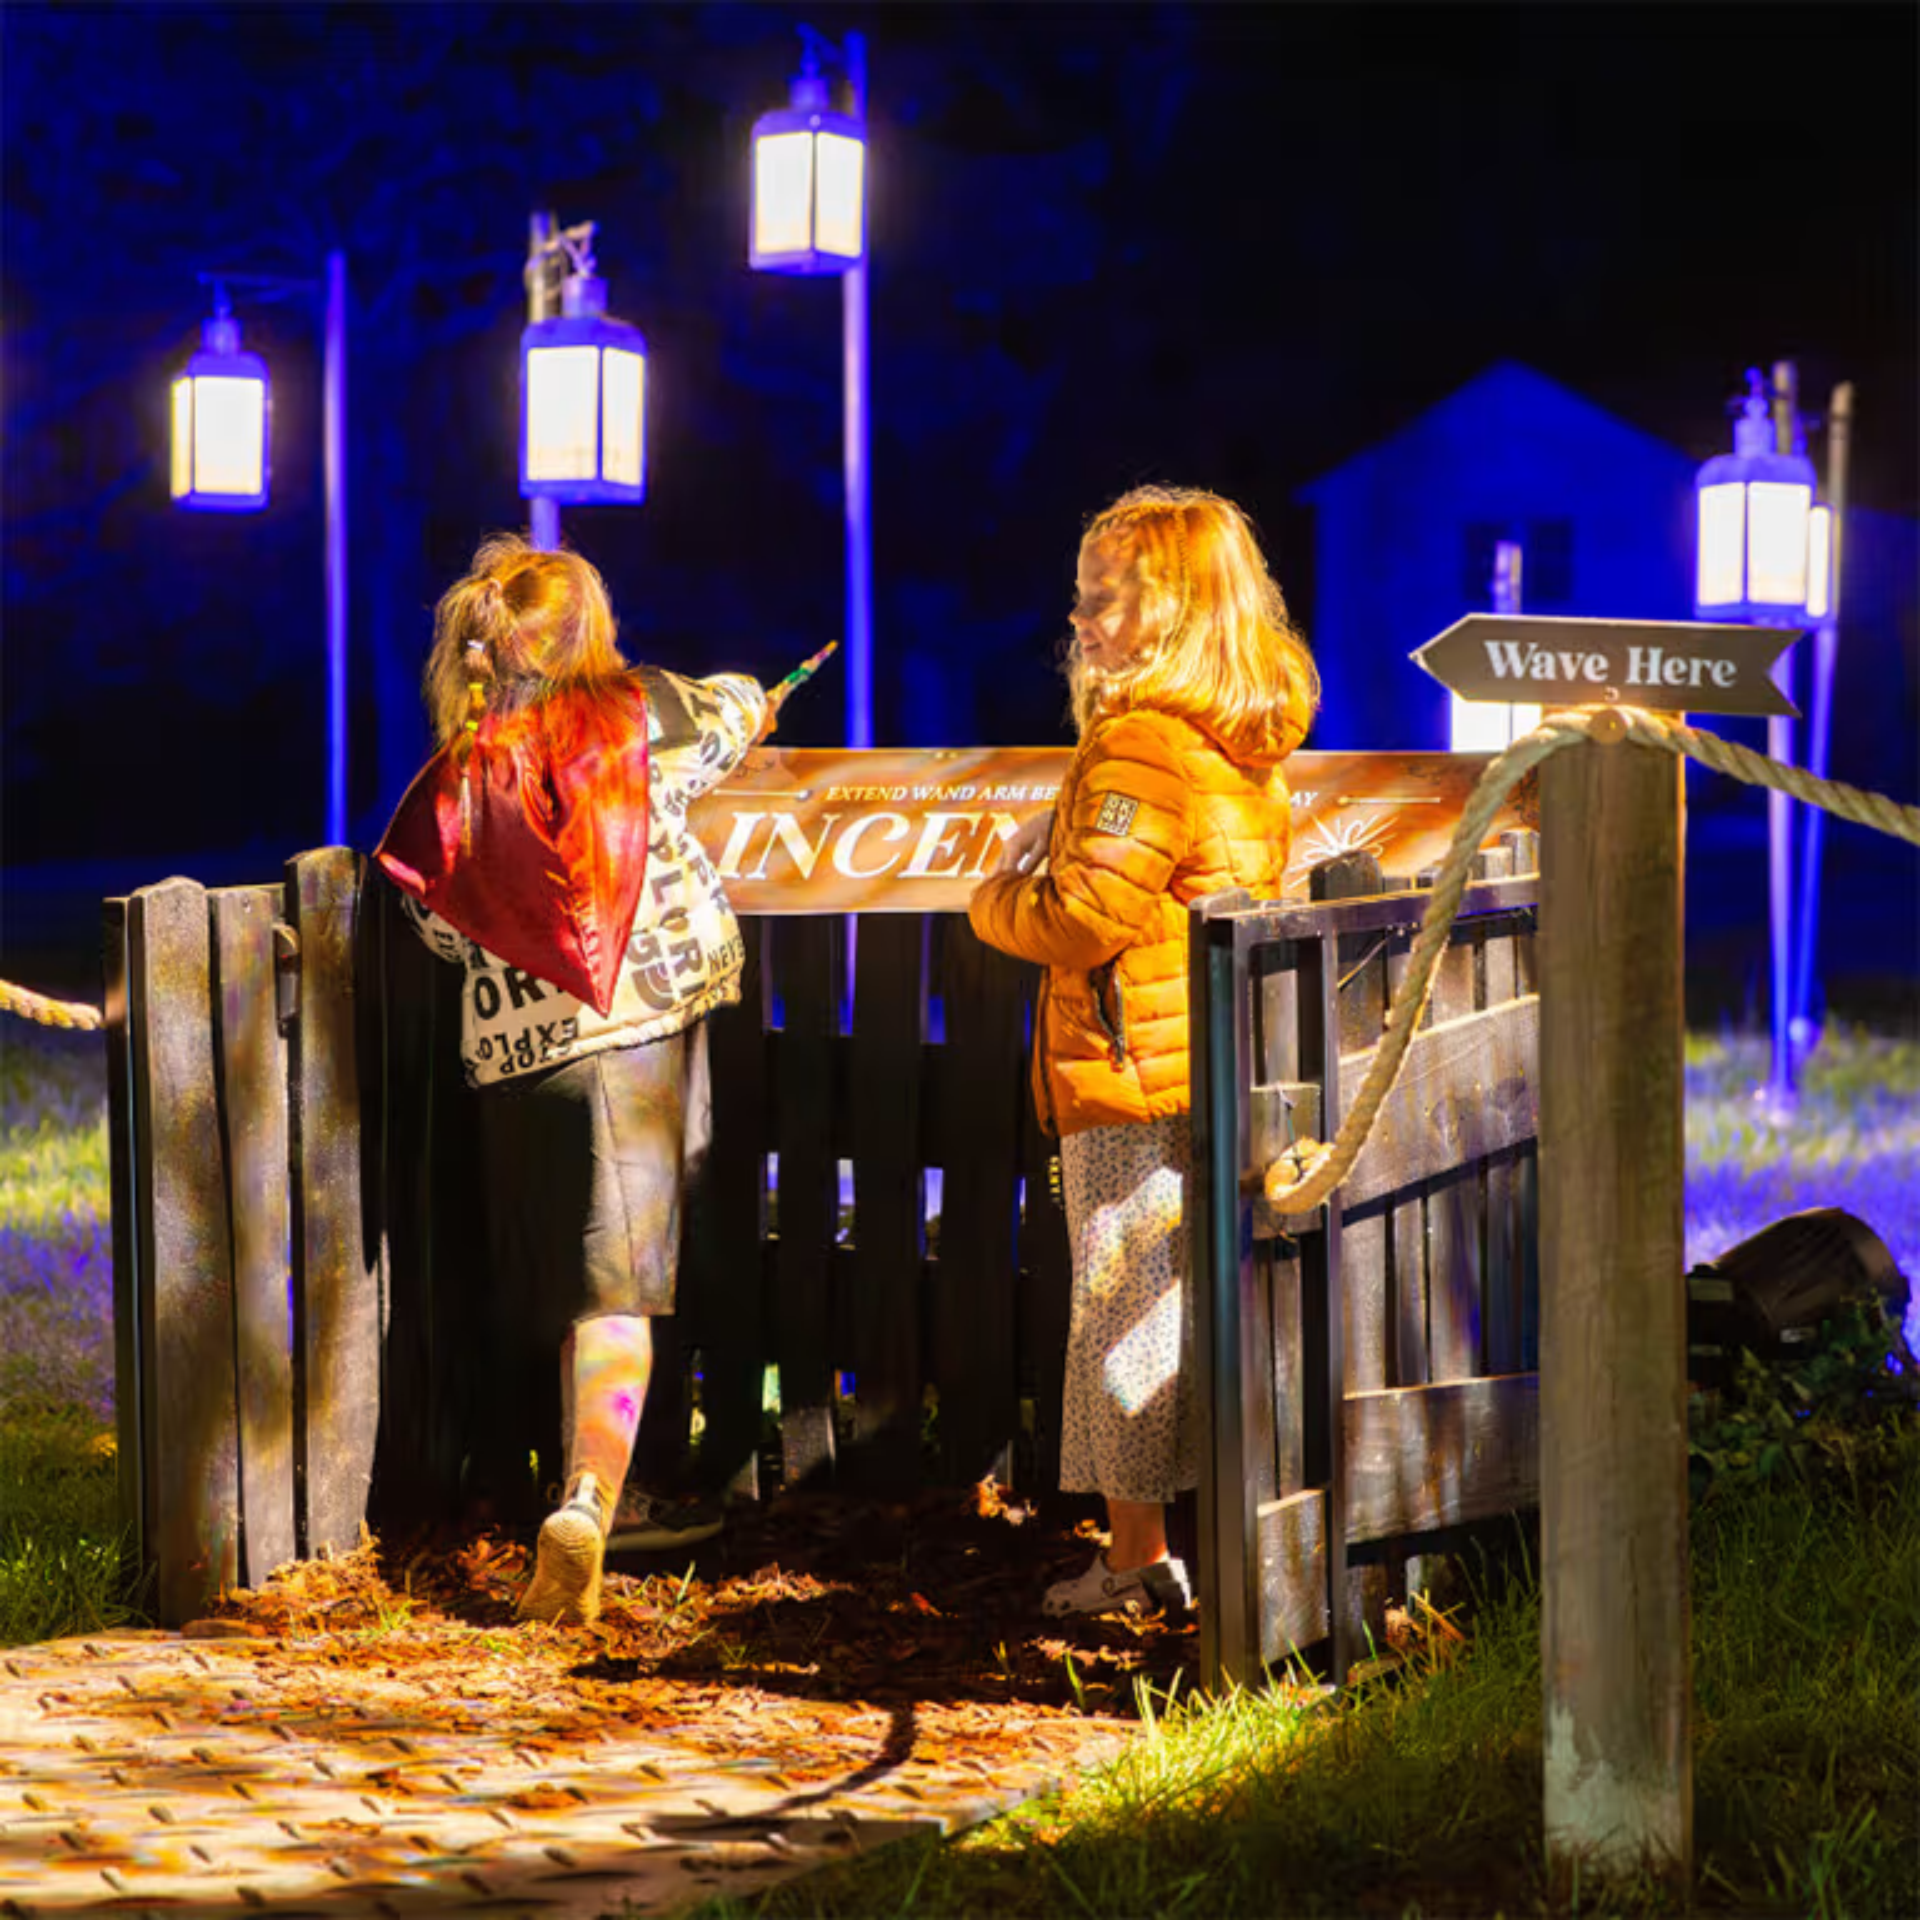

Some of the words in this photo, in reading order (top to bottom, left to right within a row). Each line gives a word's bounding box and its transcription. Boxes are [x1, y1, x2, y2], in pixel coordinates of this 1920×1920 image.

[1483, 640, 1609, 682] Wave
[1625, 646, 1738, 688] Here
[827, 786, 908, 801] EXTEND
[911, 786, 976, 800] WAND
[977, 786, 1028, 801] ARM
